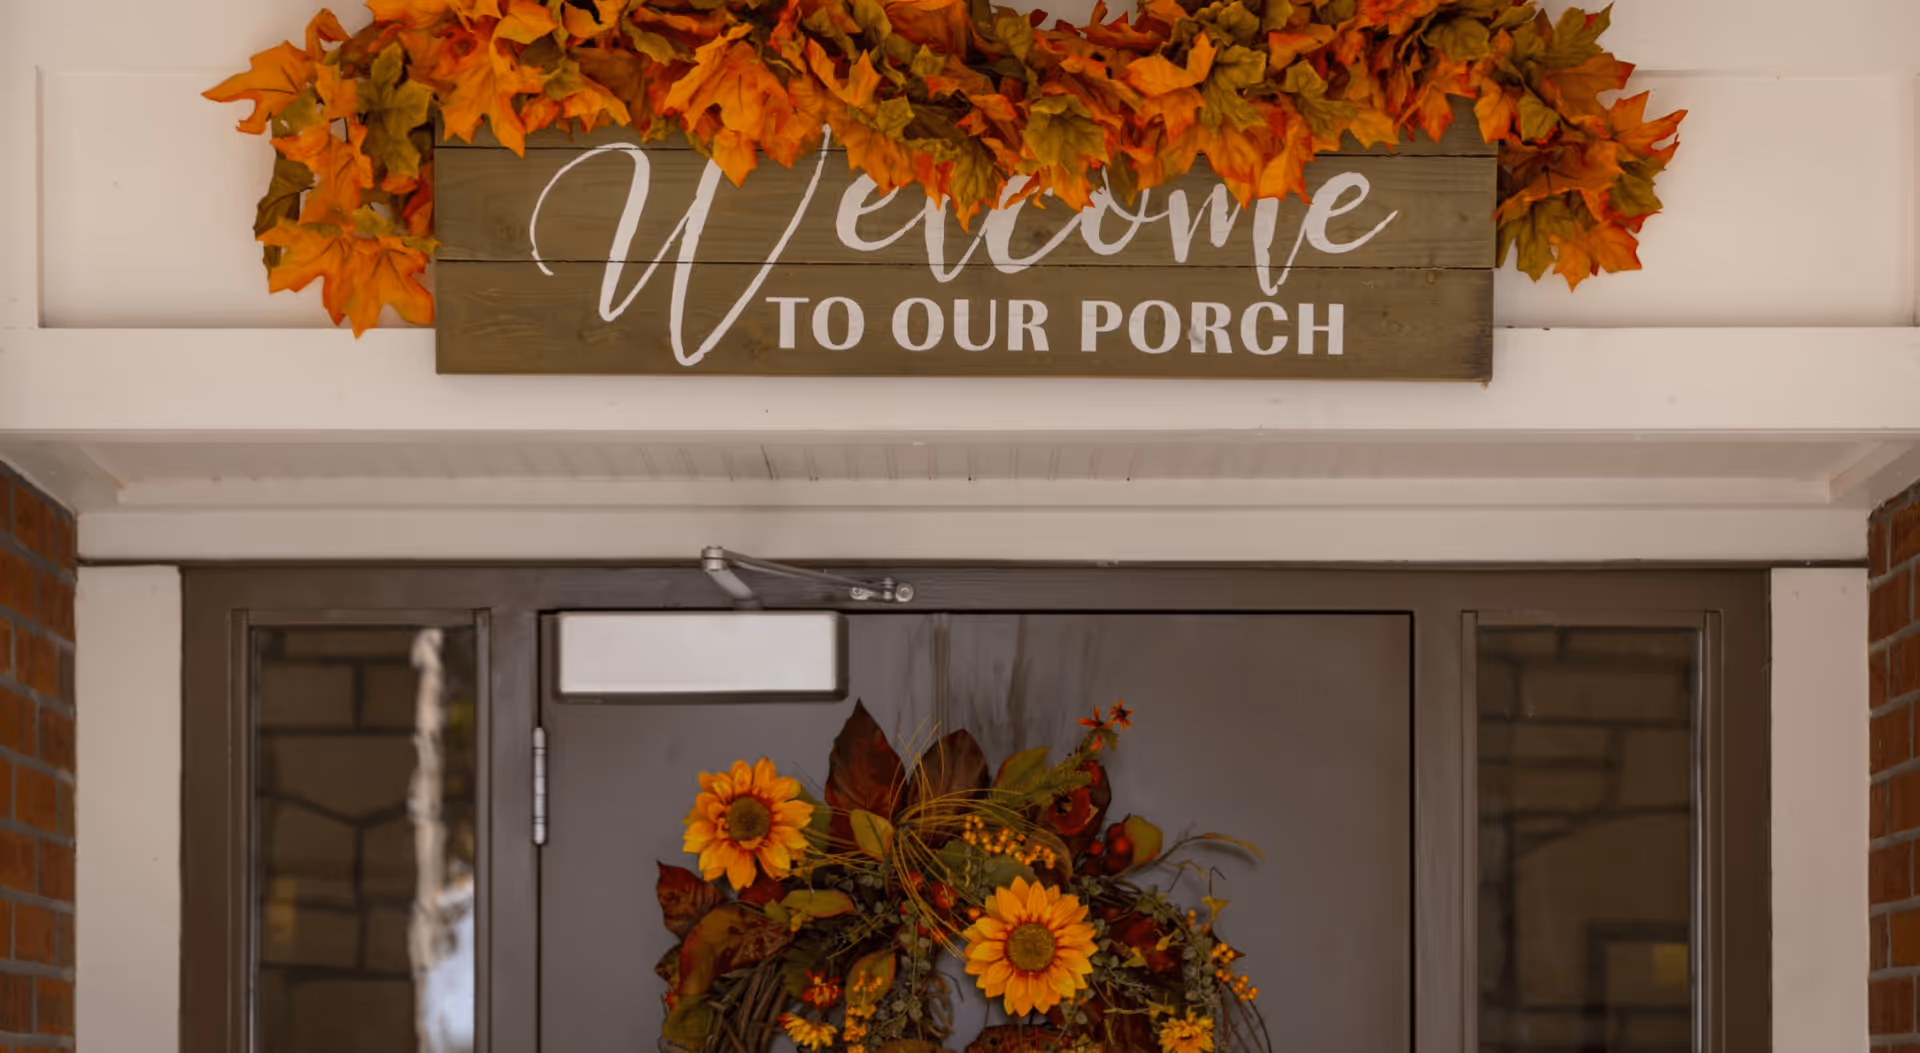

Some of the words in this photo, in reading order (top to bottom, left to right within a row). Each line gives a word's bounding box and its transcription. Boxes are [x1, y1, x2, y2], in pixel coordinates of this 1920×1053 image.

[764, 296, 865, 351] TO
[891, 297, 1050, 352] OUR
[1080, 300, 1345, 356] PORCH
